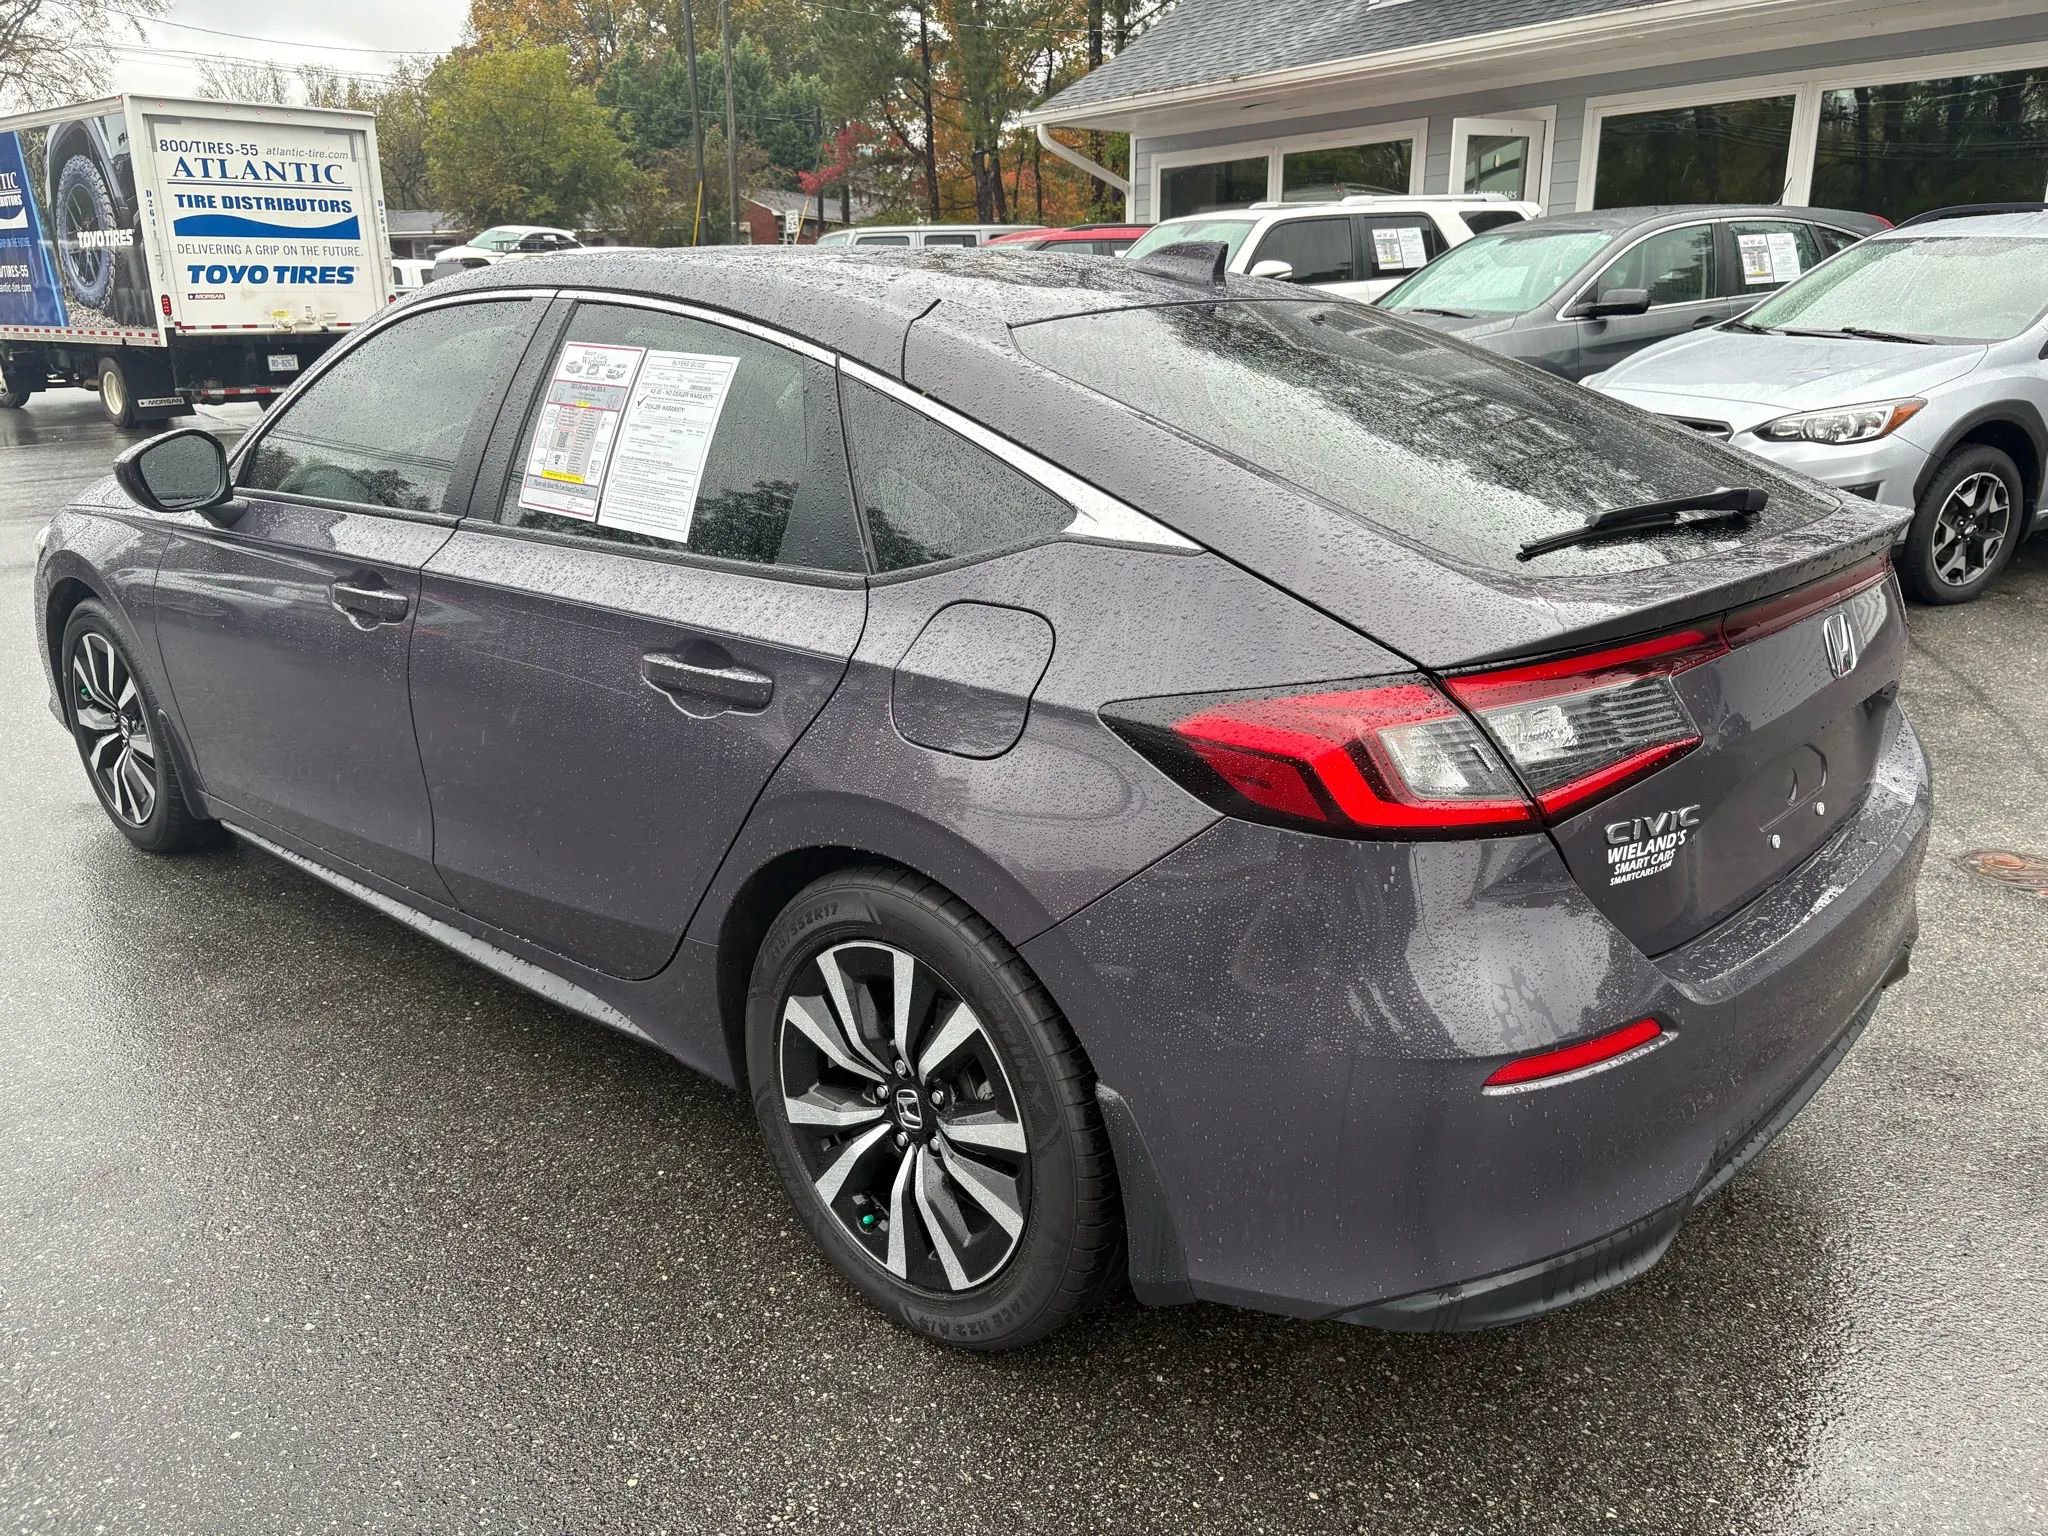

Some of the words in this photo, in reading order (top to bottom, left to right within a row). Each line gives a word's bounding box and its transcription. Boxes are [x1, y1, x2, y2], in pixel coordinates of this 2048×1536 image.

[159, 139, 259, 157] 800/TIRES-55
[265, 146, 349, 160] atlantic-tire.com
[172, 156, 345, 185] ATLANTIC
[174, 193, 218, 209] TIRE
[221, 195, 352, 213] DISTRIBUTORS
[787, 221, 798, 231] 25
[76, 230, 105, 248] TOYO
[102, 228, 134, 247] TIRES
[177, 243, 242, 255] DELIVERING
[245, 244, 253, 255] A
[255, 244, 280, 256] GRIP
[283, 245, 298, 256] ON
[300, 245, 319, 257] THE
[322, 246, 364, 257] FUTURE.
[187, 264, 269, 285] TOYO
[273, 265, 355, 285] TIRES
[672, 390, 689, 398] DEALER
[689, 392, 714, 400] WARRANTY
[1604, 804, 1701, 844] CIVIC
[1607, 829, 1687, 864] WIELAND'S
[1613, 855, 1650, 875] SMART
[1650, 848, 1676, 865] CARS
[1609, 859, 1673, 886] SMARTCARS1.COM
